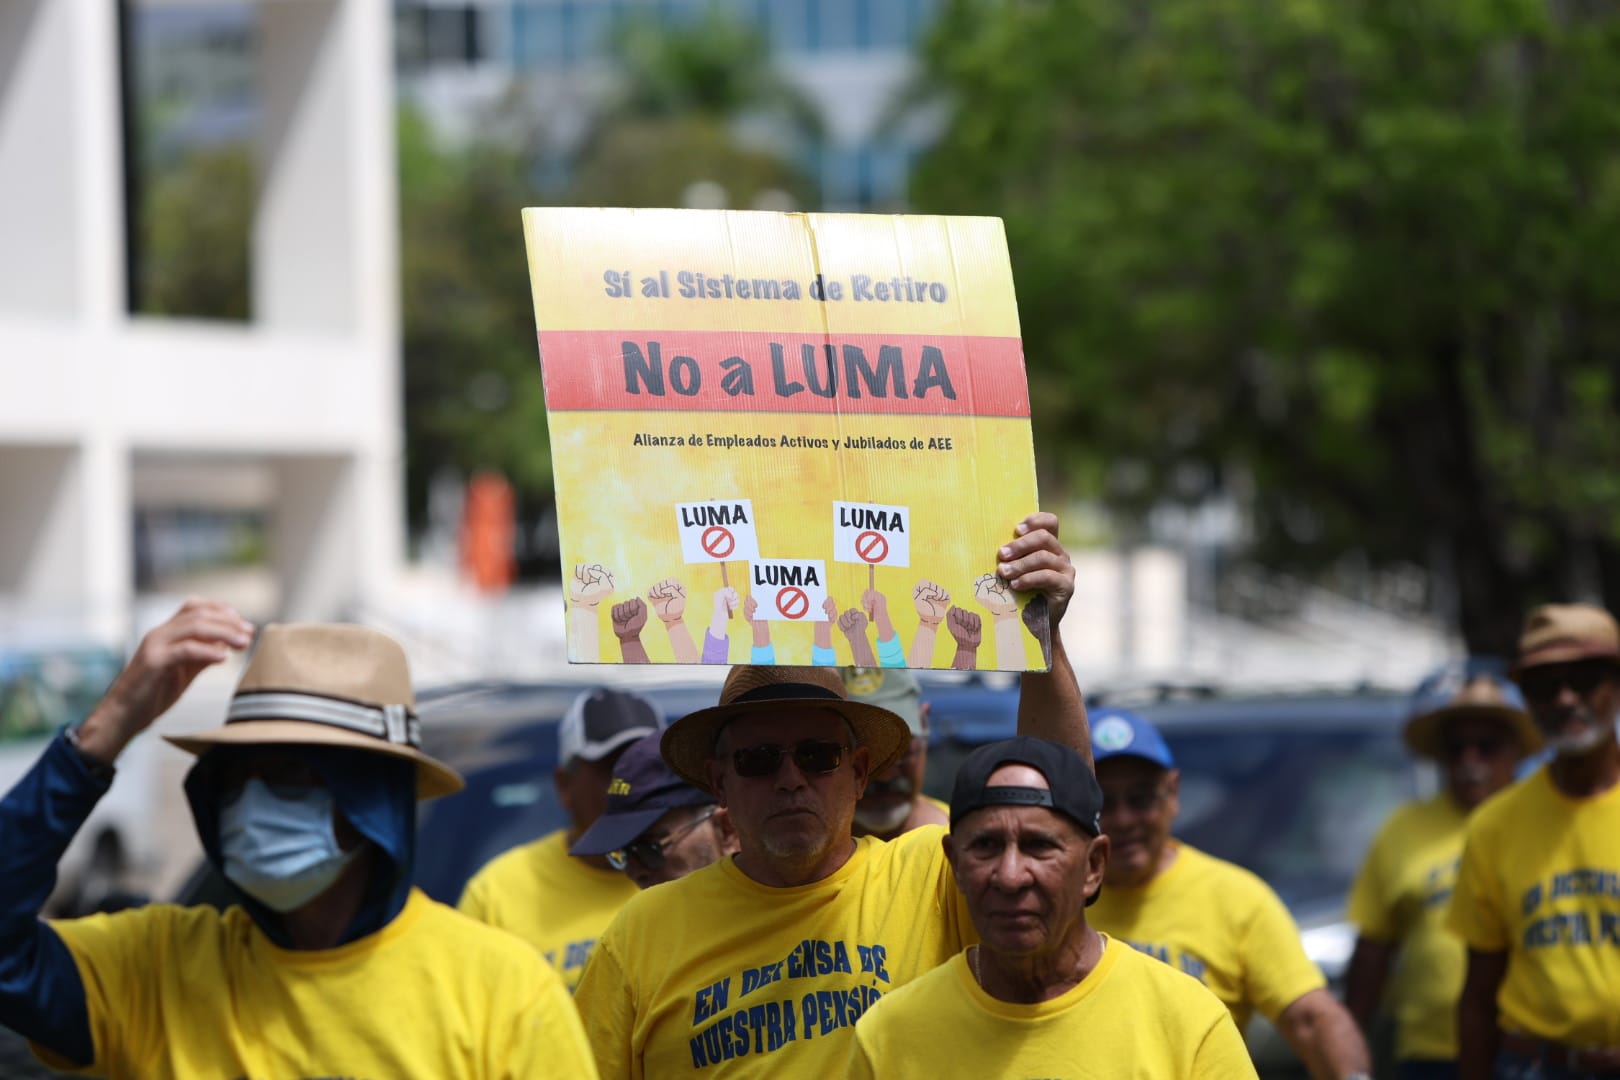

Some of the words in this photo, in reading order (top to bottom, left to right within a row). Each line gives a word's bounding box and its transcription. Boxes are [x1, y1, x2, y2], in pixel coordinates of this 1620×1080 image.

[603, 269, 632, 298] Sí
[640, 270, 670, 299] al
[677, 271, 802, 300] Sistema
[809, 273, 843, 301] de
[851, 274, 949, 303] Retiro
[621, 340, 701, 396] No
[719, 356, 755, 396] a
[769, 342, 957, 400] LUMA
[633, 433, 685, 447] Alianza
[688, 434, 703, 446] de
[706, 434, 777, 449] Empleados
[780, 435, 829, 448] Activos
[832, 439, 840, 449] y
[844, 437, 907, 450] Jubilados
[909, 438, 925, 450] de
[928, 438, 953, 450] AEE
[682, 504, 748, 527] LUMA
[840, 507, 904, 533] LUMA
[754, 565, 820, 587] LUMA
[693, 977, 730, 1026] EN
[857, 945, 890, 984] DE
[689, 1000, 797, 1069] NUESTRA
[802, 979, 888, 1040] PENSIÓ
